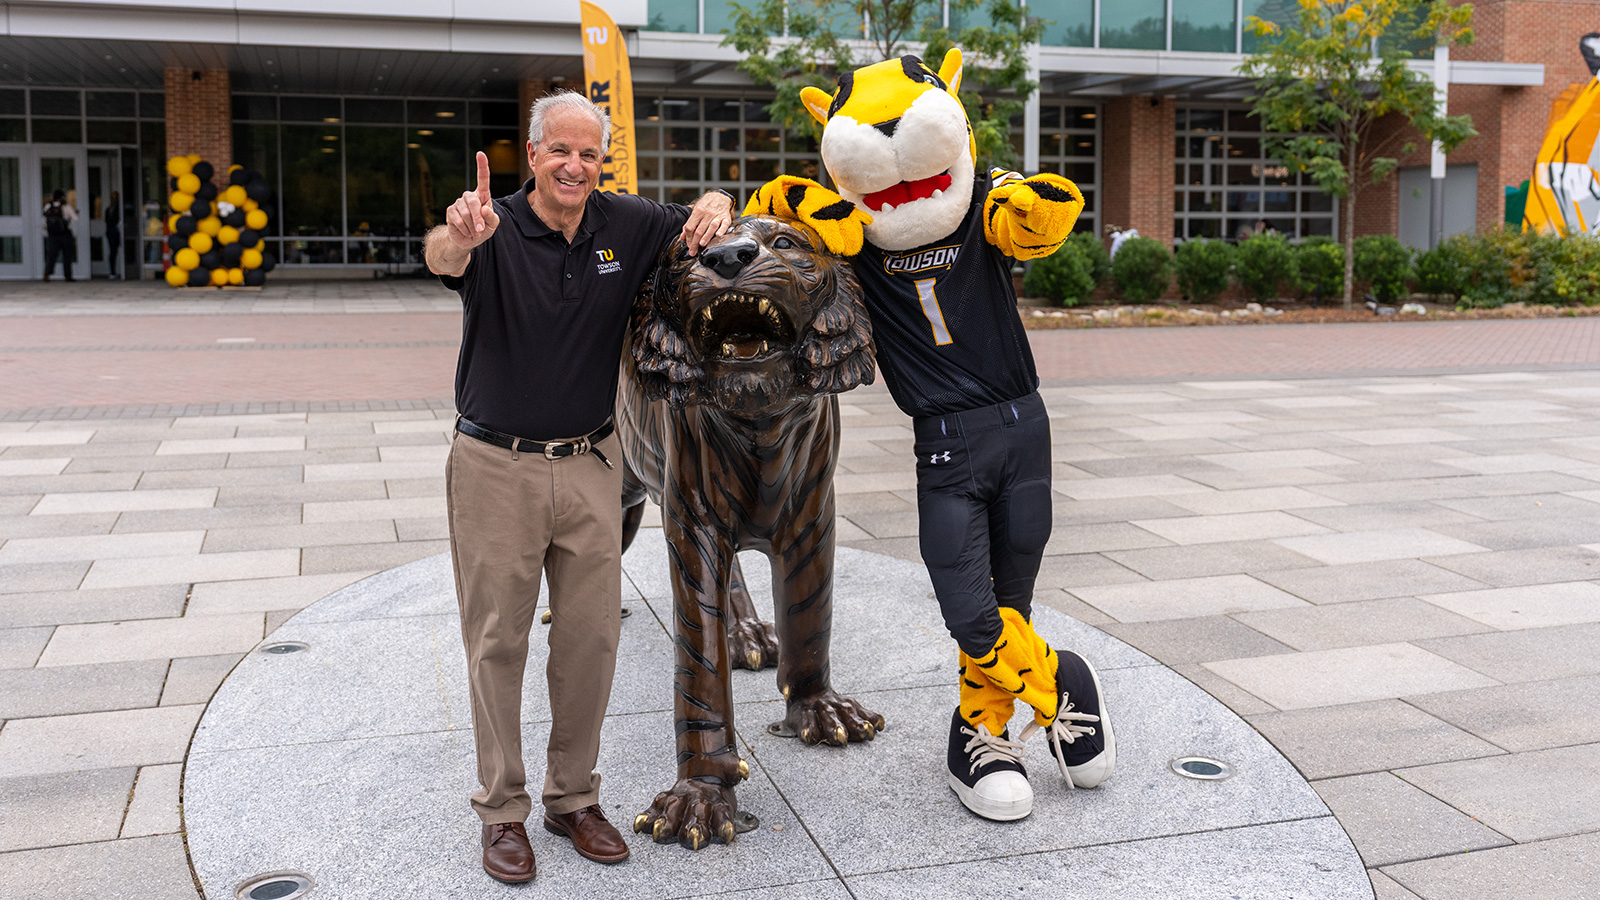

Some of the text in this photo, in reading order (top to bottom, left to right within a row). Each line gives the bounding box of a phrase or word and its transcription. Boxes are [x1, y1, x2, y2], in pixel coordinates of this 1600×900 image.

[585, 26, 608, 45] TU
[590, 80, 616, 187] TIR
[596, 248, 614, 262] TU
[596, 261, 620, 270] TOWSON
[884, 246, 961, 271] TOWSON
[914, 278, 954, 346] 1
